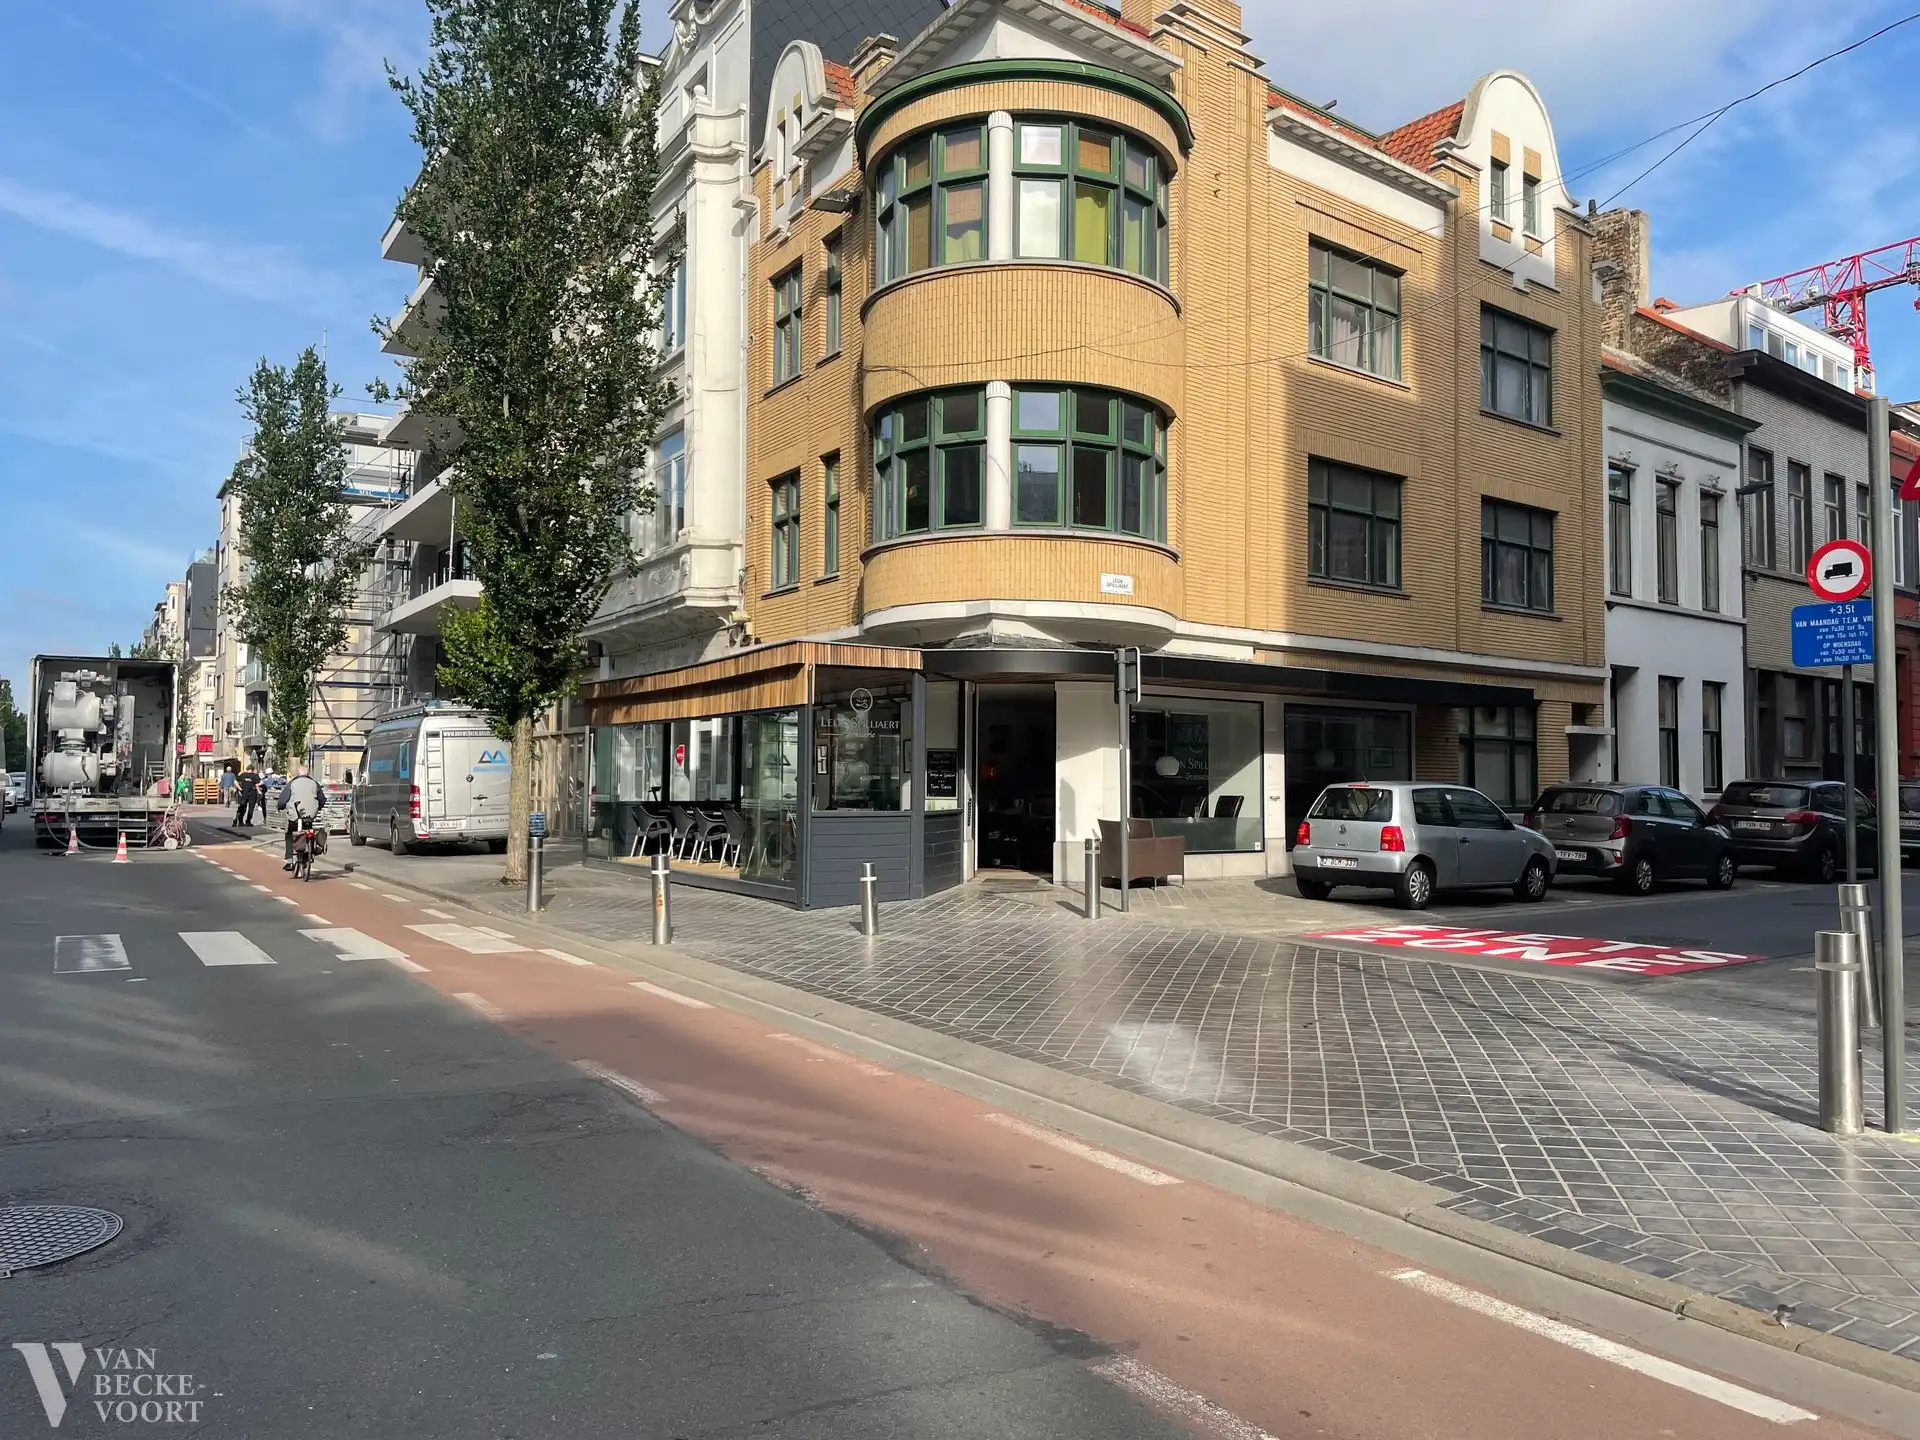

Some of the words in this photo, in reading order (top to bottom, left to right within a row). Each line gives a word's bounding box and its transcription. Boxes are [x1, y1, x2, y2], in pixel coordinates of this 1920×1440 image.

[1810, 618, 1840, 626] MAANDAG
[1833, 640, 1862, 648] WOENSDAG
[1323, 930, 1685, 972] ZONE
